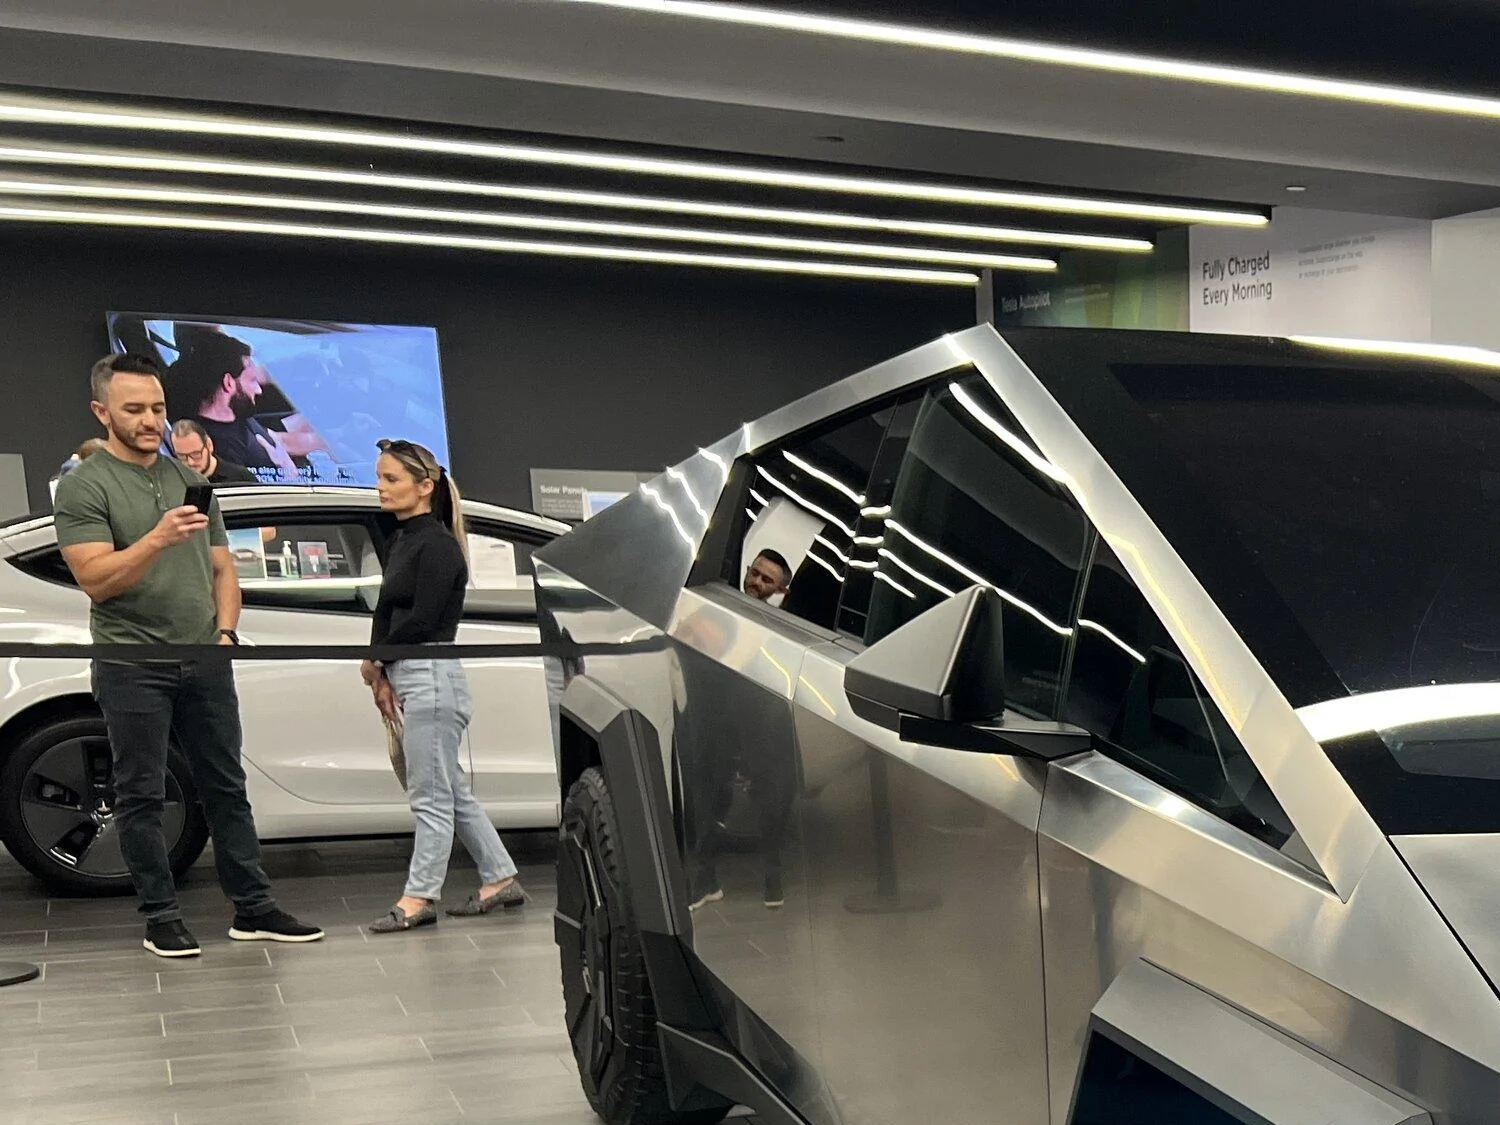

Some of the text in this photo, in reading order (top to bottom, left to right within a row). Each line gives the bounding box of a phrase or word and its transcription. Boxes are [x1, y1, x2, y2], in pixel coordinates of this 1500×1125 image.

[1202, 259, 1226, 281] Fully
[1227, 249, 1270, 276] Charged
[1202, 279, 1273, 306] Every Morning
[540, 484, 560, 495] Solar
